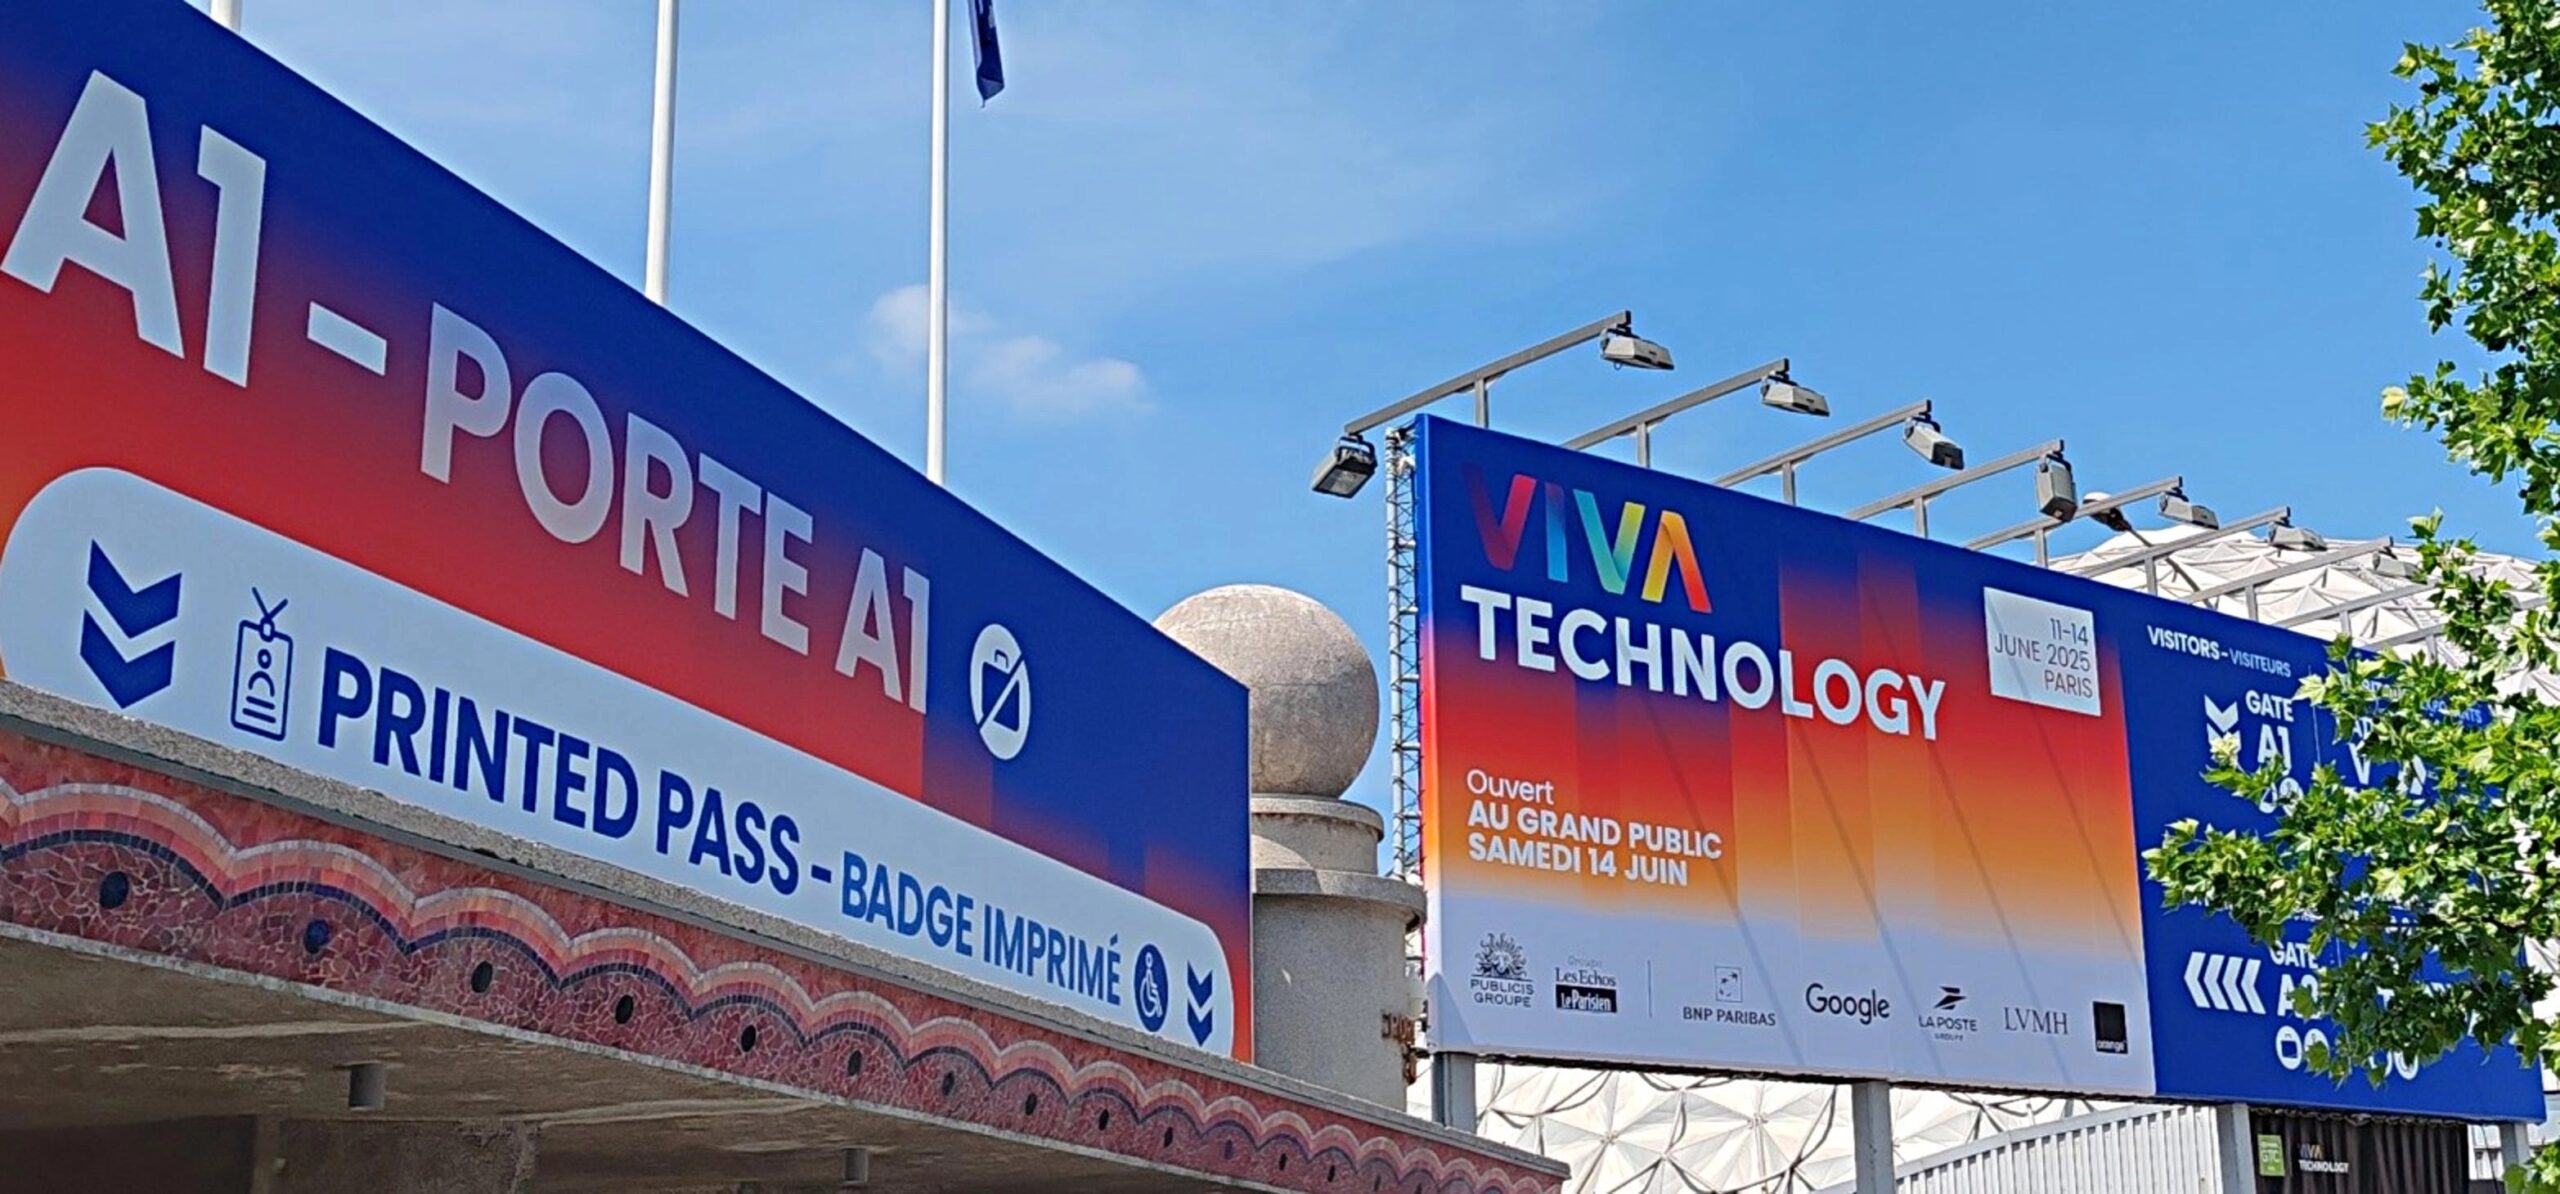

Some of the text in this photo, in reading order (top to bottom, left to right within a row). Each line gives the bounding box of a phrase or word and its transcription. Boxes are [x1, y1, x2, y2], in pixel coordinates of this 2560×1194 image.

[1, 69, 266, 388] A1
[420, 301, 813, 656] PORTE
[835, 547, 930, 714] A1
[1463, 461, 1713, 614] VIVA
[2050, 618, 2088, 646] 11-14
[1461, 584, 1945, 740] TECHNOLOGY
[1994, 633, 2091, 672] JUNE 2025
[2147, 624, 2220, 660] VISITORS
[2229, 648, 2291, 678] VISITEURS
[2044, 669, 2093, 699] PARIS
[2245, 689, 2294, 722] GATE
[1466, 769, 1554, 805] Ouvert
[317, 646, 639, 839] PRINTED
[656, 769, 800, 895] PASS
[841, 851, 973, 957] BADGE
[983, 908, 1121, 1006] IMPRIMÉ
[1467, 799, 1722, 860] AU GRAND PUBLIC
[1468, 832, 1687, 886] SAMEDI 14 JUIN
[2270, 939, 2318, 969] GATE
[1470, 978, 1535, 996] PUBLICIS
[1554, 967, 1617, 987] Les Echos
[1474, 992, 1532, 1008] GROUPE
[1683, 1005, 1776, 1027] BNP PARIBAS
[1805, 983, 1890, 1026] Google
[1918, 1015, 1978, 1032] LA POSTE
[2004, 1006, 2069, 1036] LVMH
[2096, 1039, 2126, 1053] orange
